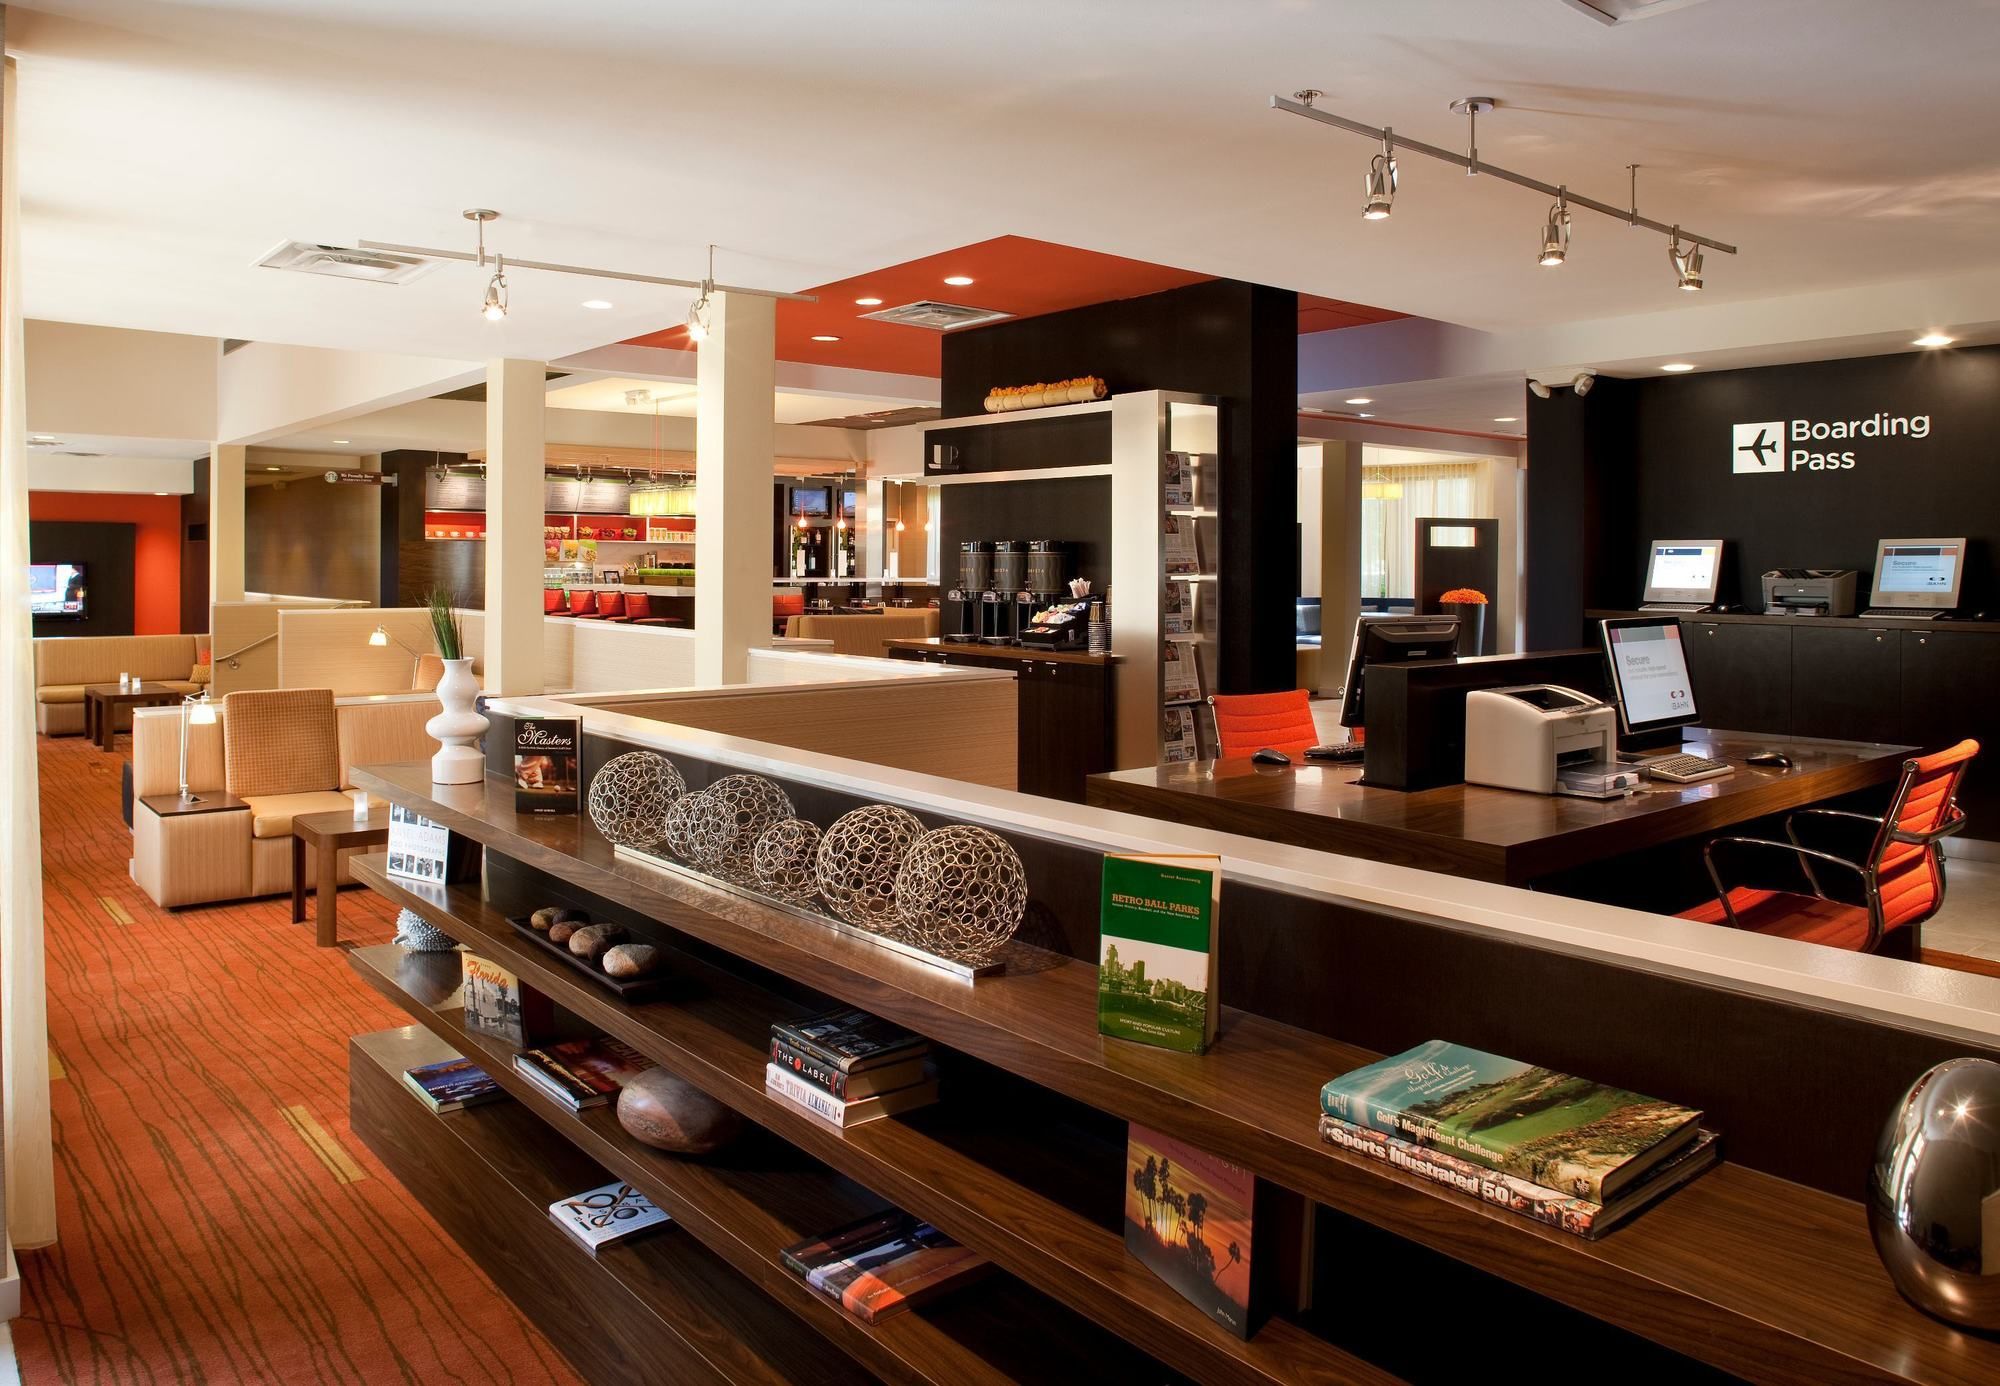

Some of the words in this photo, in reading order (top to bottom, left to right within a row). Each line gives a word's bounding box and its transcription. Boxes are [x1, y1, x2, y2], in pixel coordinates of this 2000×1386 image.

[1791, 412, 1930, 441] Boarding
[1791, 449, 1856, 472] Pass
[1625, 655, 1651, 667] Secure
[518, 729, 573, 746] Masters
[523, 722, 537, 730] The
[1112, 893, 1144, 906] RETRO
[1144, 898, 1168, 910] BALL
[1168, 902, 1201, 916] PARKS
[466, 960, 509, 988] Florida
[777, 1049, 794, 1065] THE
[802, 1063, 830, 1085] LABEL
[1404, 1062, 1450, 1085] Golf's
[785, 1080, 807, 1104] TRIVIA
[1376, 1110, 1401, 1128] Golf's
[1402, 1118, 1456, 1147] Magnificent
[1457, 1137, 1504, 1164] Challenge
[1331, 1127, 1386, 1160] Sports
[1389, 1145, 1479, 1193] Illustrated
[1482, 1180, 1509, 1204] 50
